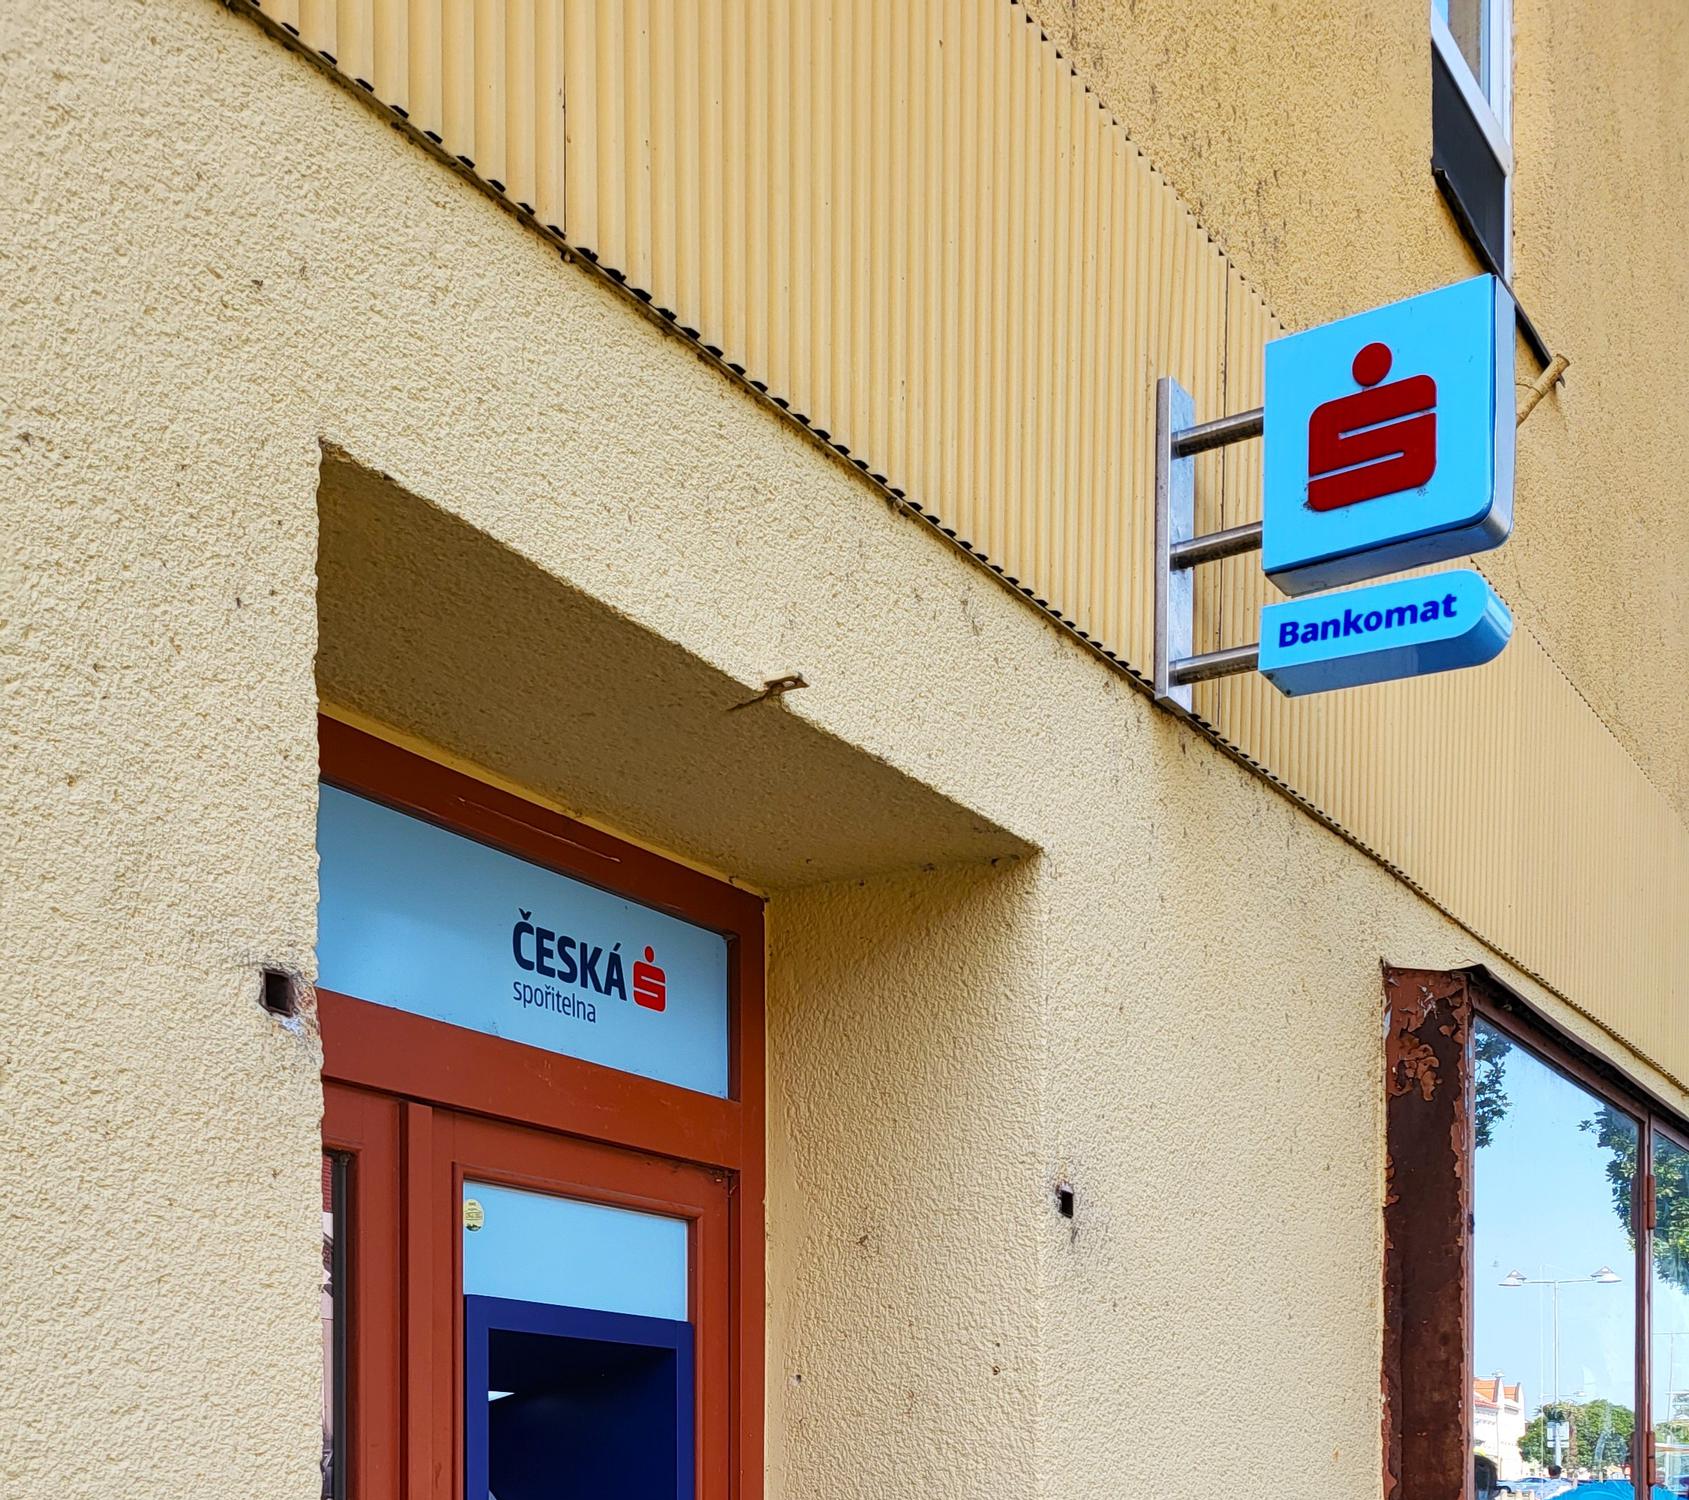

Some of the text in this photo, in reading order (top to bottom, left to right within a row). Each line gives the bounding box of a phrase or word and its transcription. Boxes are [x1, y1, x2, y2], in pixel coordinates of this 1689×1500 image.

[1279, 593, 1457, 648] Bankomat
[513, 907, 628, 1001] ČESKÁ
[513, 980, 596, 1024] spořitelna
